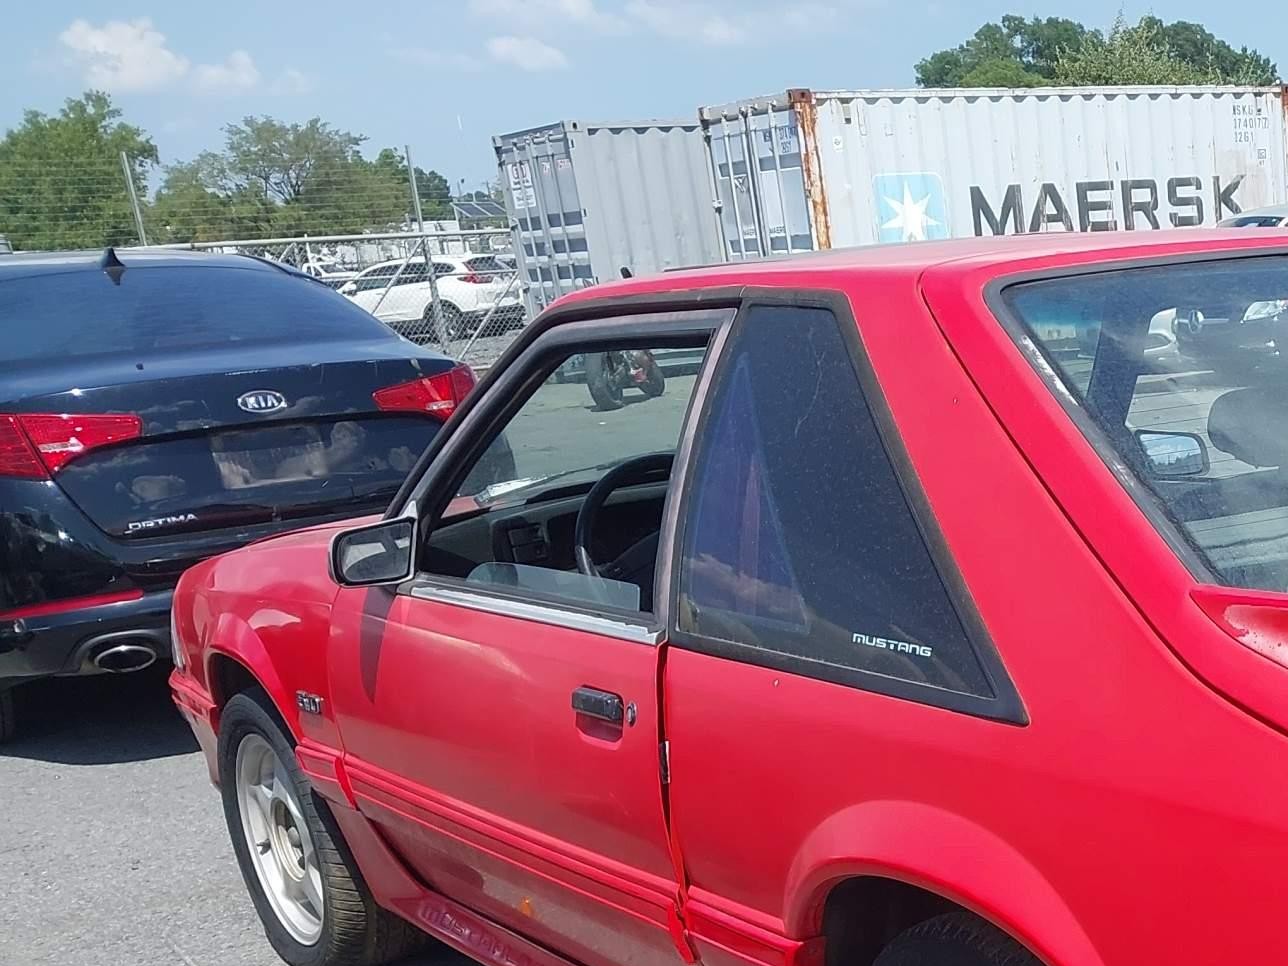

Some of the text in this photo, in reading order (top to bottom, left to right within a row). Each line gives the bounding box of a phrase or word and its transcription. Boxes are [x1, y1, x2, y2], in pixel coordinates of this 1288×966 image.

[969, 174, 1247, 237] MAERSK
[244, 395, 279, 409] KIA
[124, 513, 199, 534] OPTIMA
[852, 632, 933, 657] MUSTANG
